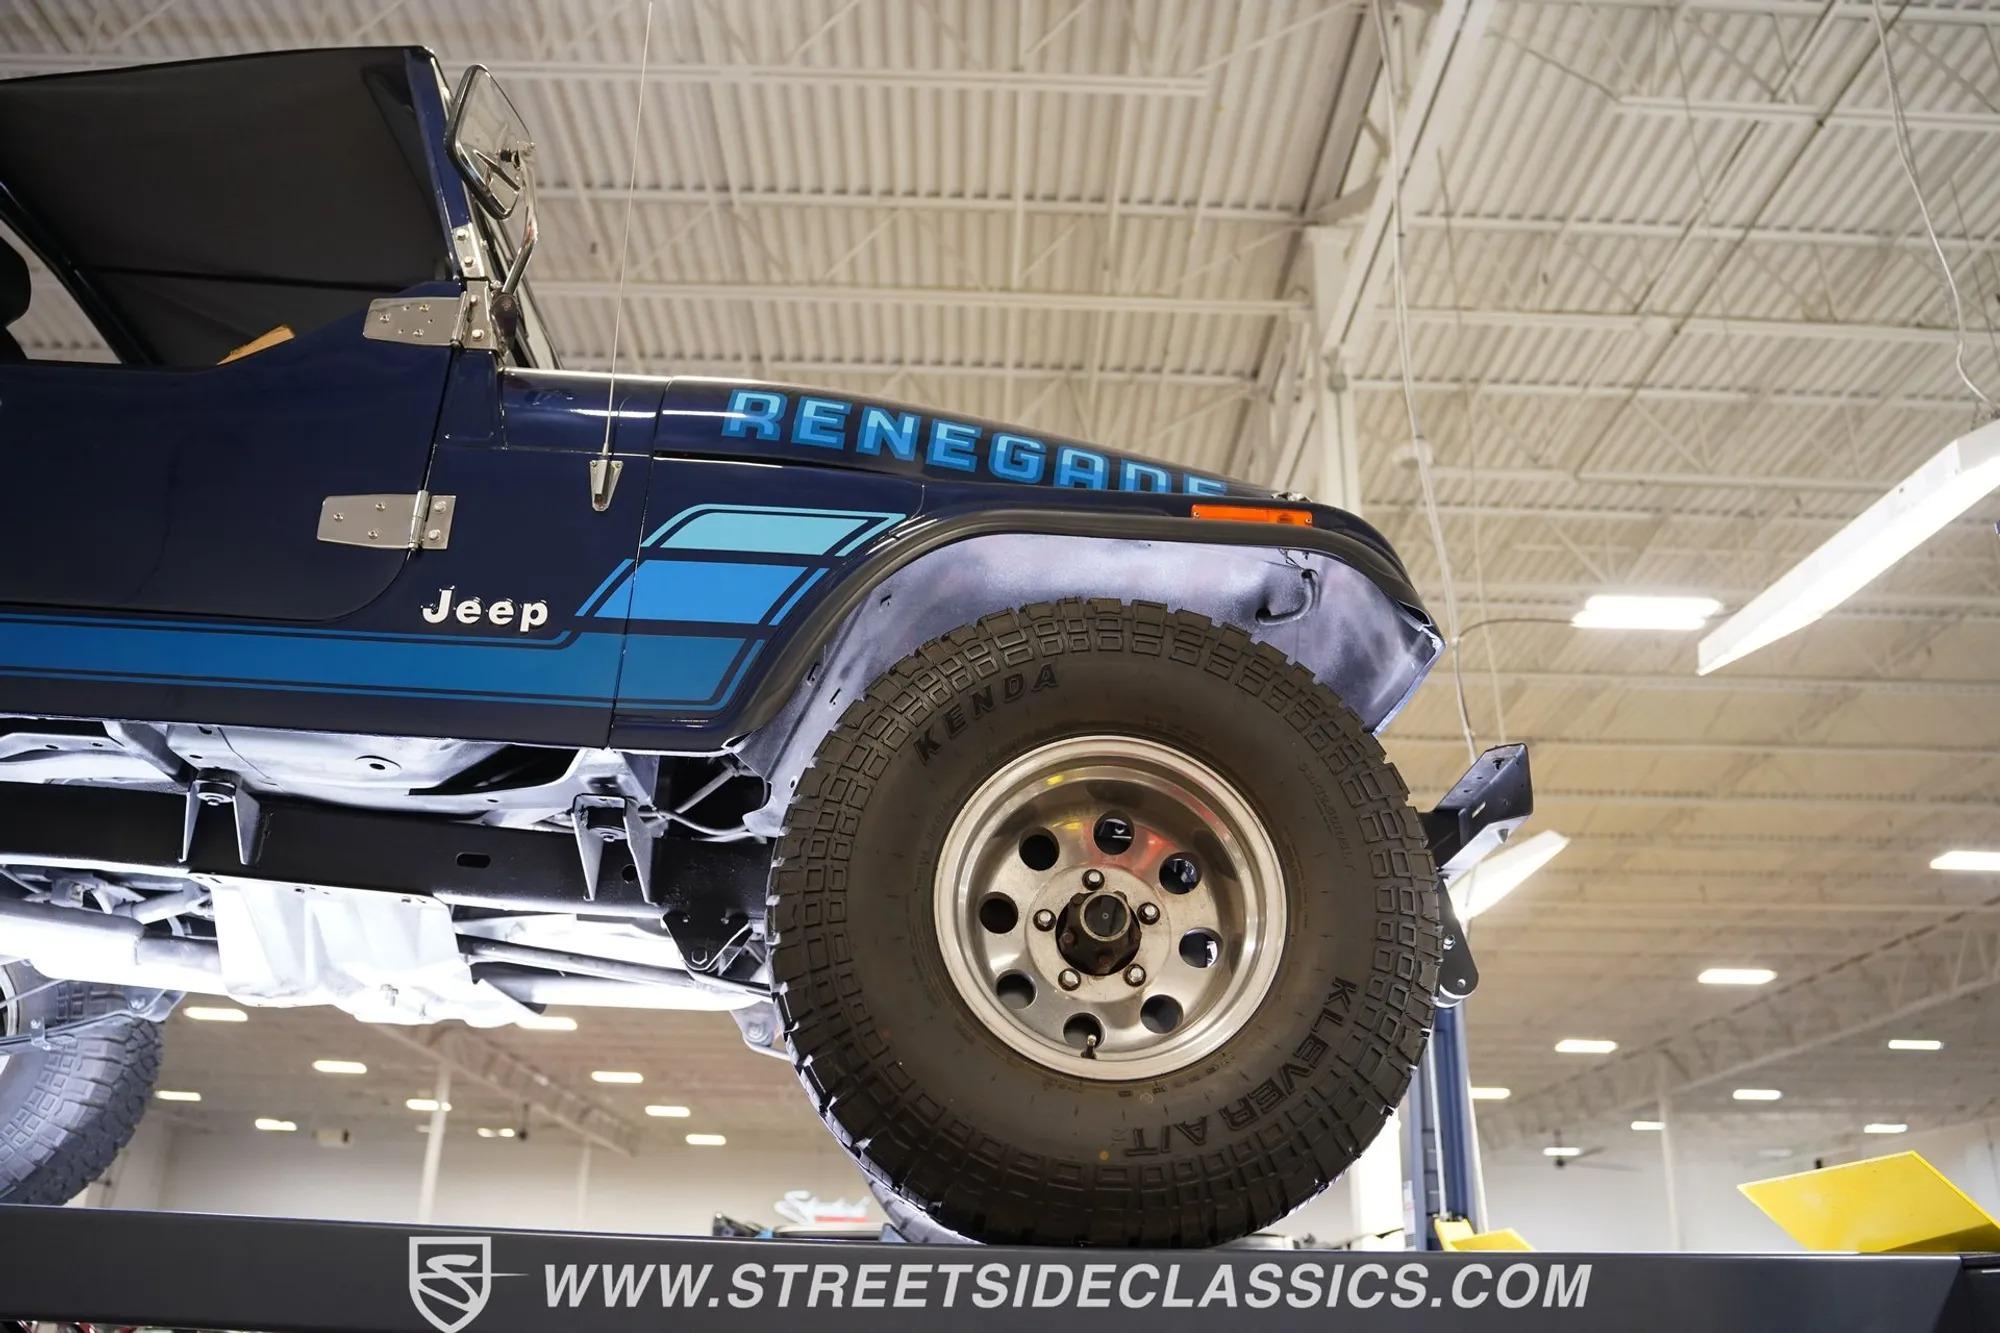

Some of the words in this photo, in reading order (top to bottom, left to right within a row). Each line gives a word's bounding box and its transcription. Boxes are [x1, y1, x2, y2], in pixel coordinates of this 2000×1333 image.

[421, 586, 549, 633] Jeep
[912, 663, 1058, 767] KENDA
[1218, 976, 1358, 1132] KLEVER
[1123, 1115, 1209, 1156] A/T
